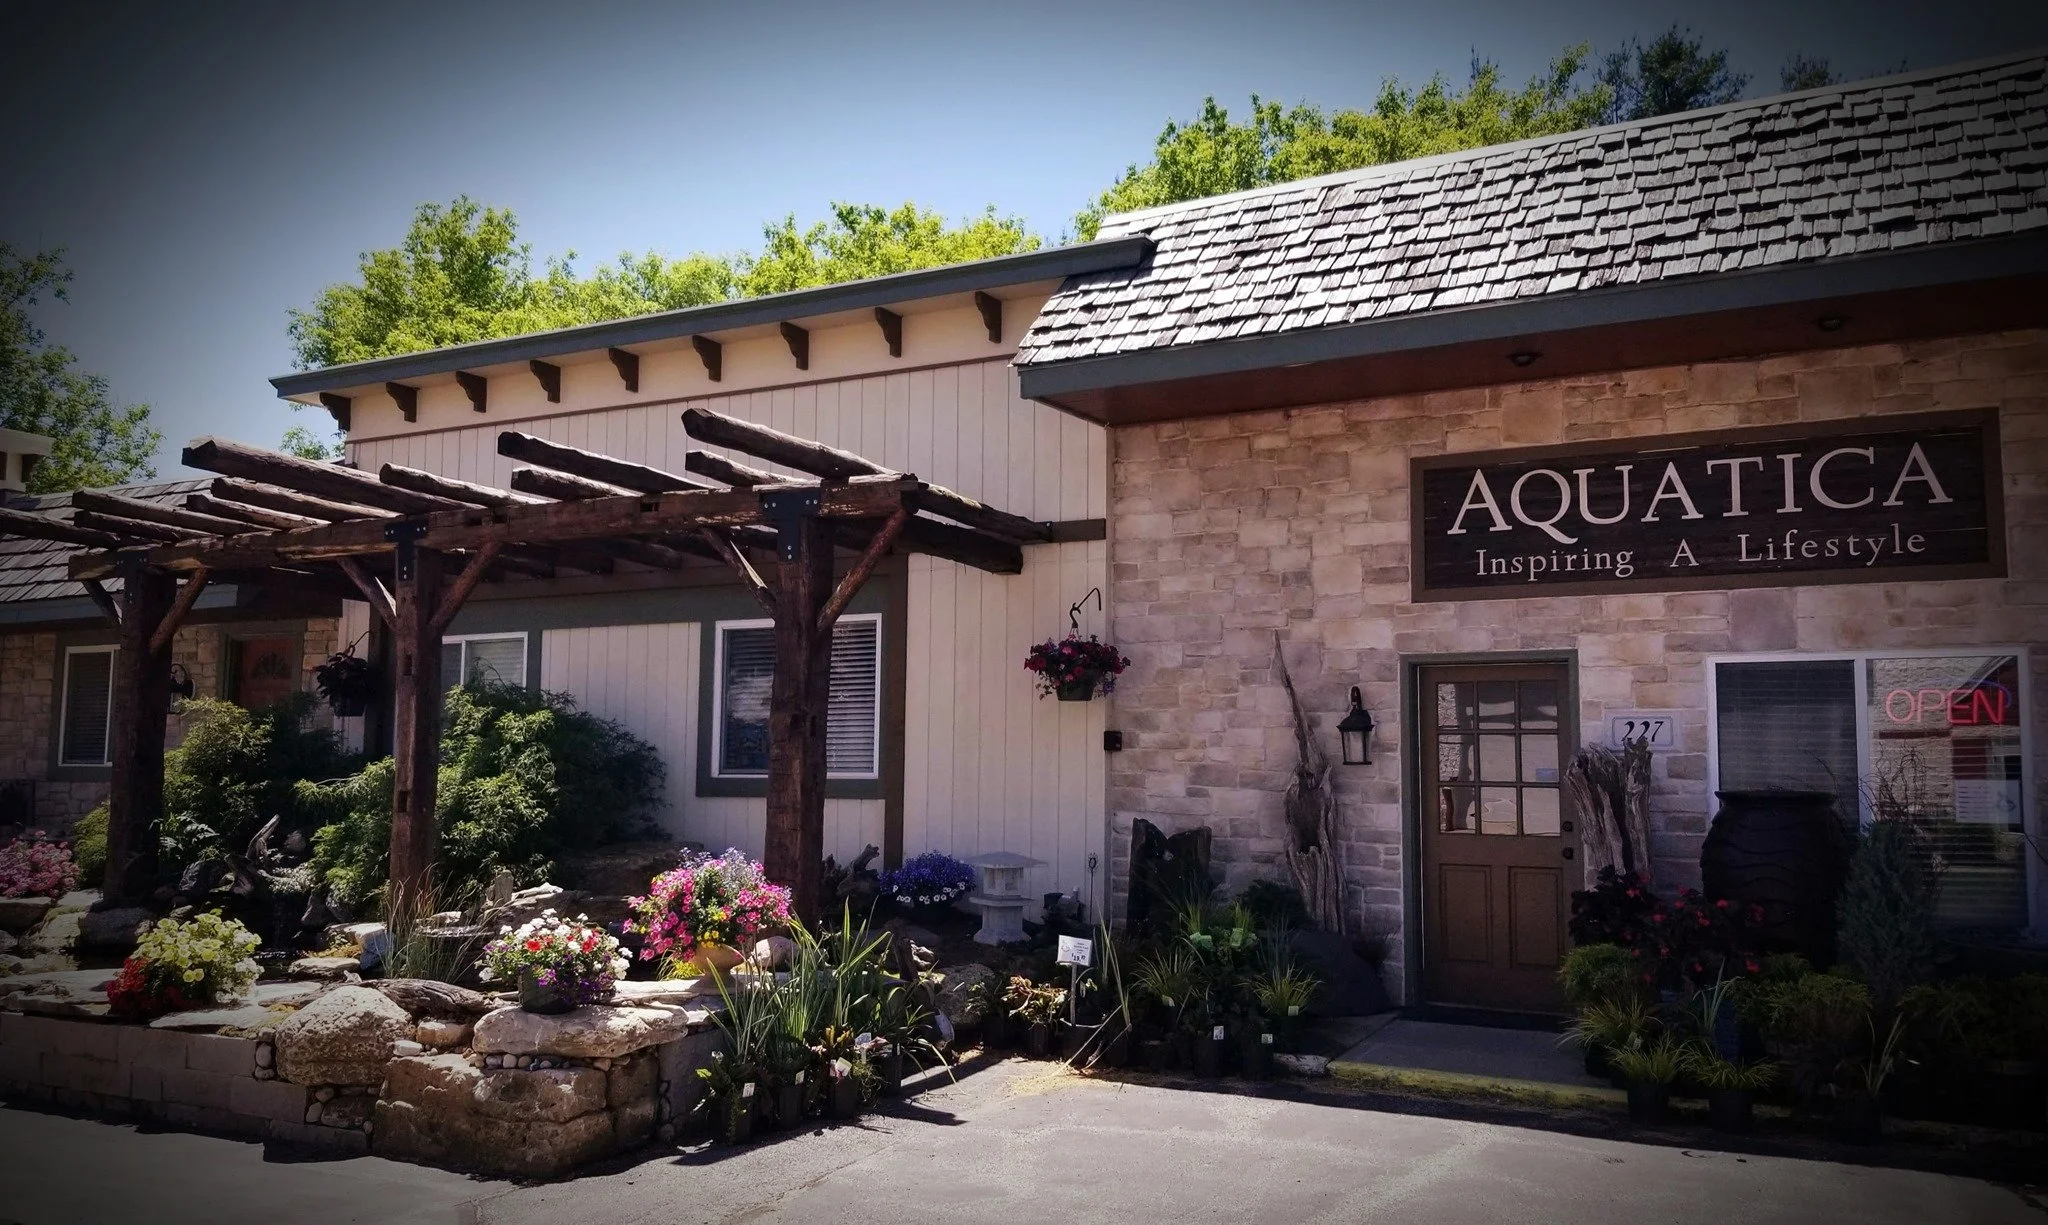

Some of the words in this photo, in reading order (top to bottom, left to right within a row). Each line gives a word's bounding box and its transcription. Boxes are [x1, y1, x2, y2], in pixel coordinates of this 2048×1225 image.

[1446, 440, 1954, 545] AQUATICA
[1475, 546, 1635, 582] Inspiring
[1669, 538, 1700, 568] A
[1737, 523, 1928, 567] Lifestyle
[1886, 688, 2005, 725] OPEN
[1621, 720, 1664, 742] 227
